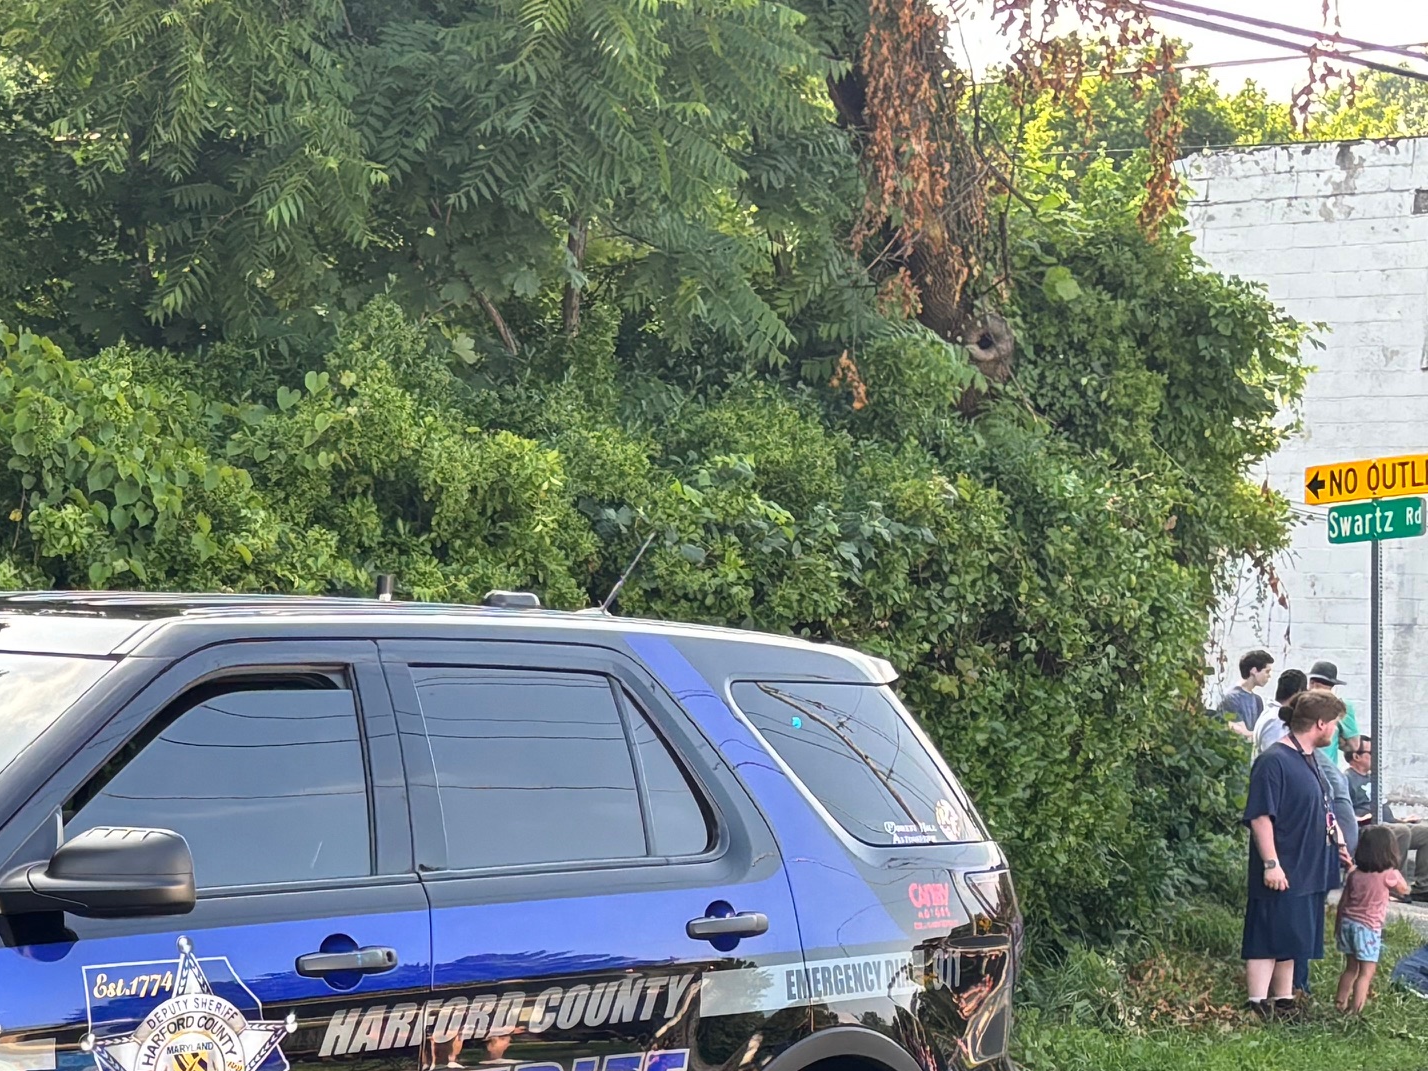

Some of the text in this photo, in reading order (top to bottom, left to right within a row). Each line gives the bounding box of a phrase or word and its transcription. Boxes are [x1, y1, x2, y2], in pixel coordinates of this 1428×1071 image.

[1329, 460, 1428, 497] NO OUTL
[1329, 505, 1422, 538] Swartz Rd
[93, 971, 173, 999] Est.1774
[785, 959, 882, 1001] EMERGENCY
[146, 997, 239, 1031] DEPUTY SHERIFF
[318, 973, 694, 1058] HARFORD COUNTY
[141, 1014, 238, 1067] HARFORD COUNTY
[166, 1041, 214, 1056] MARYLAND
